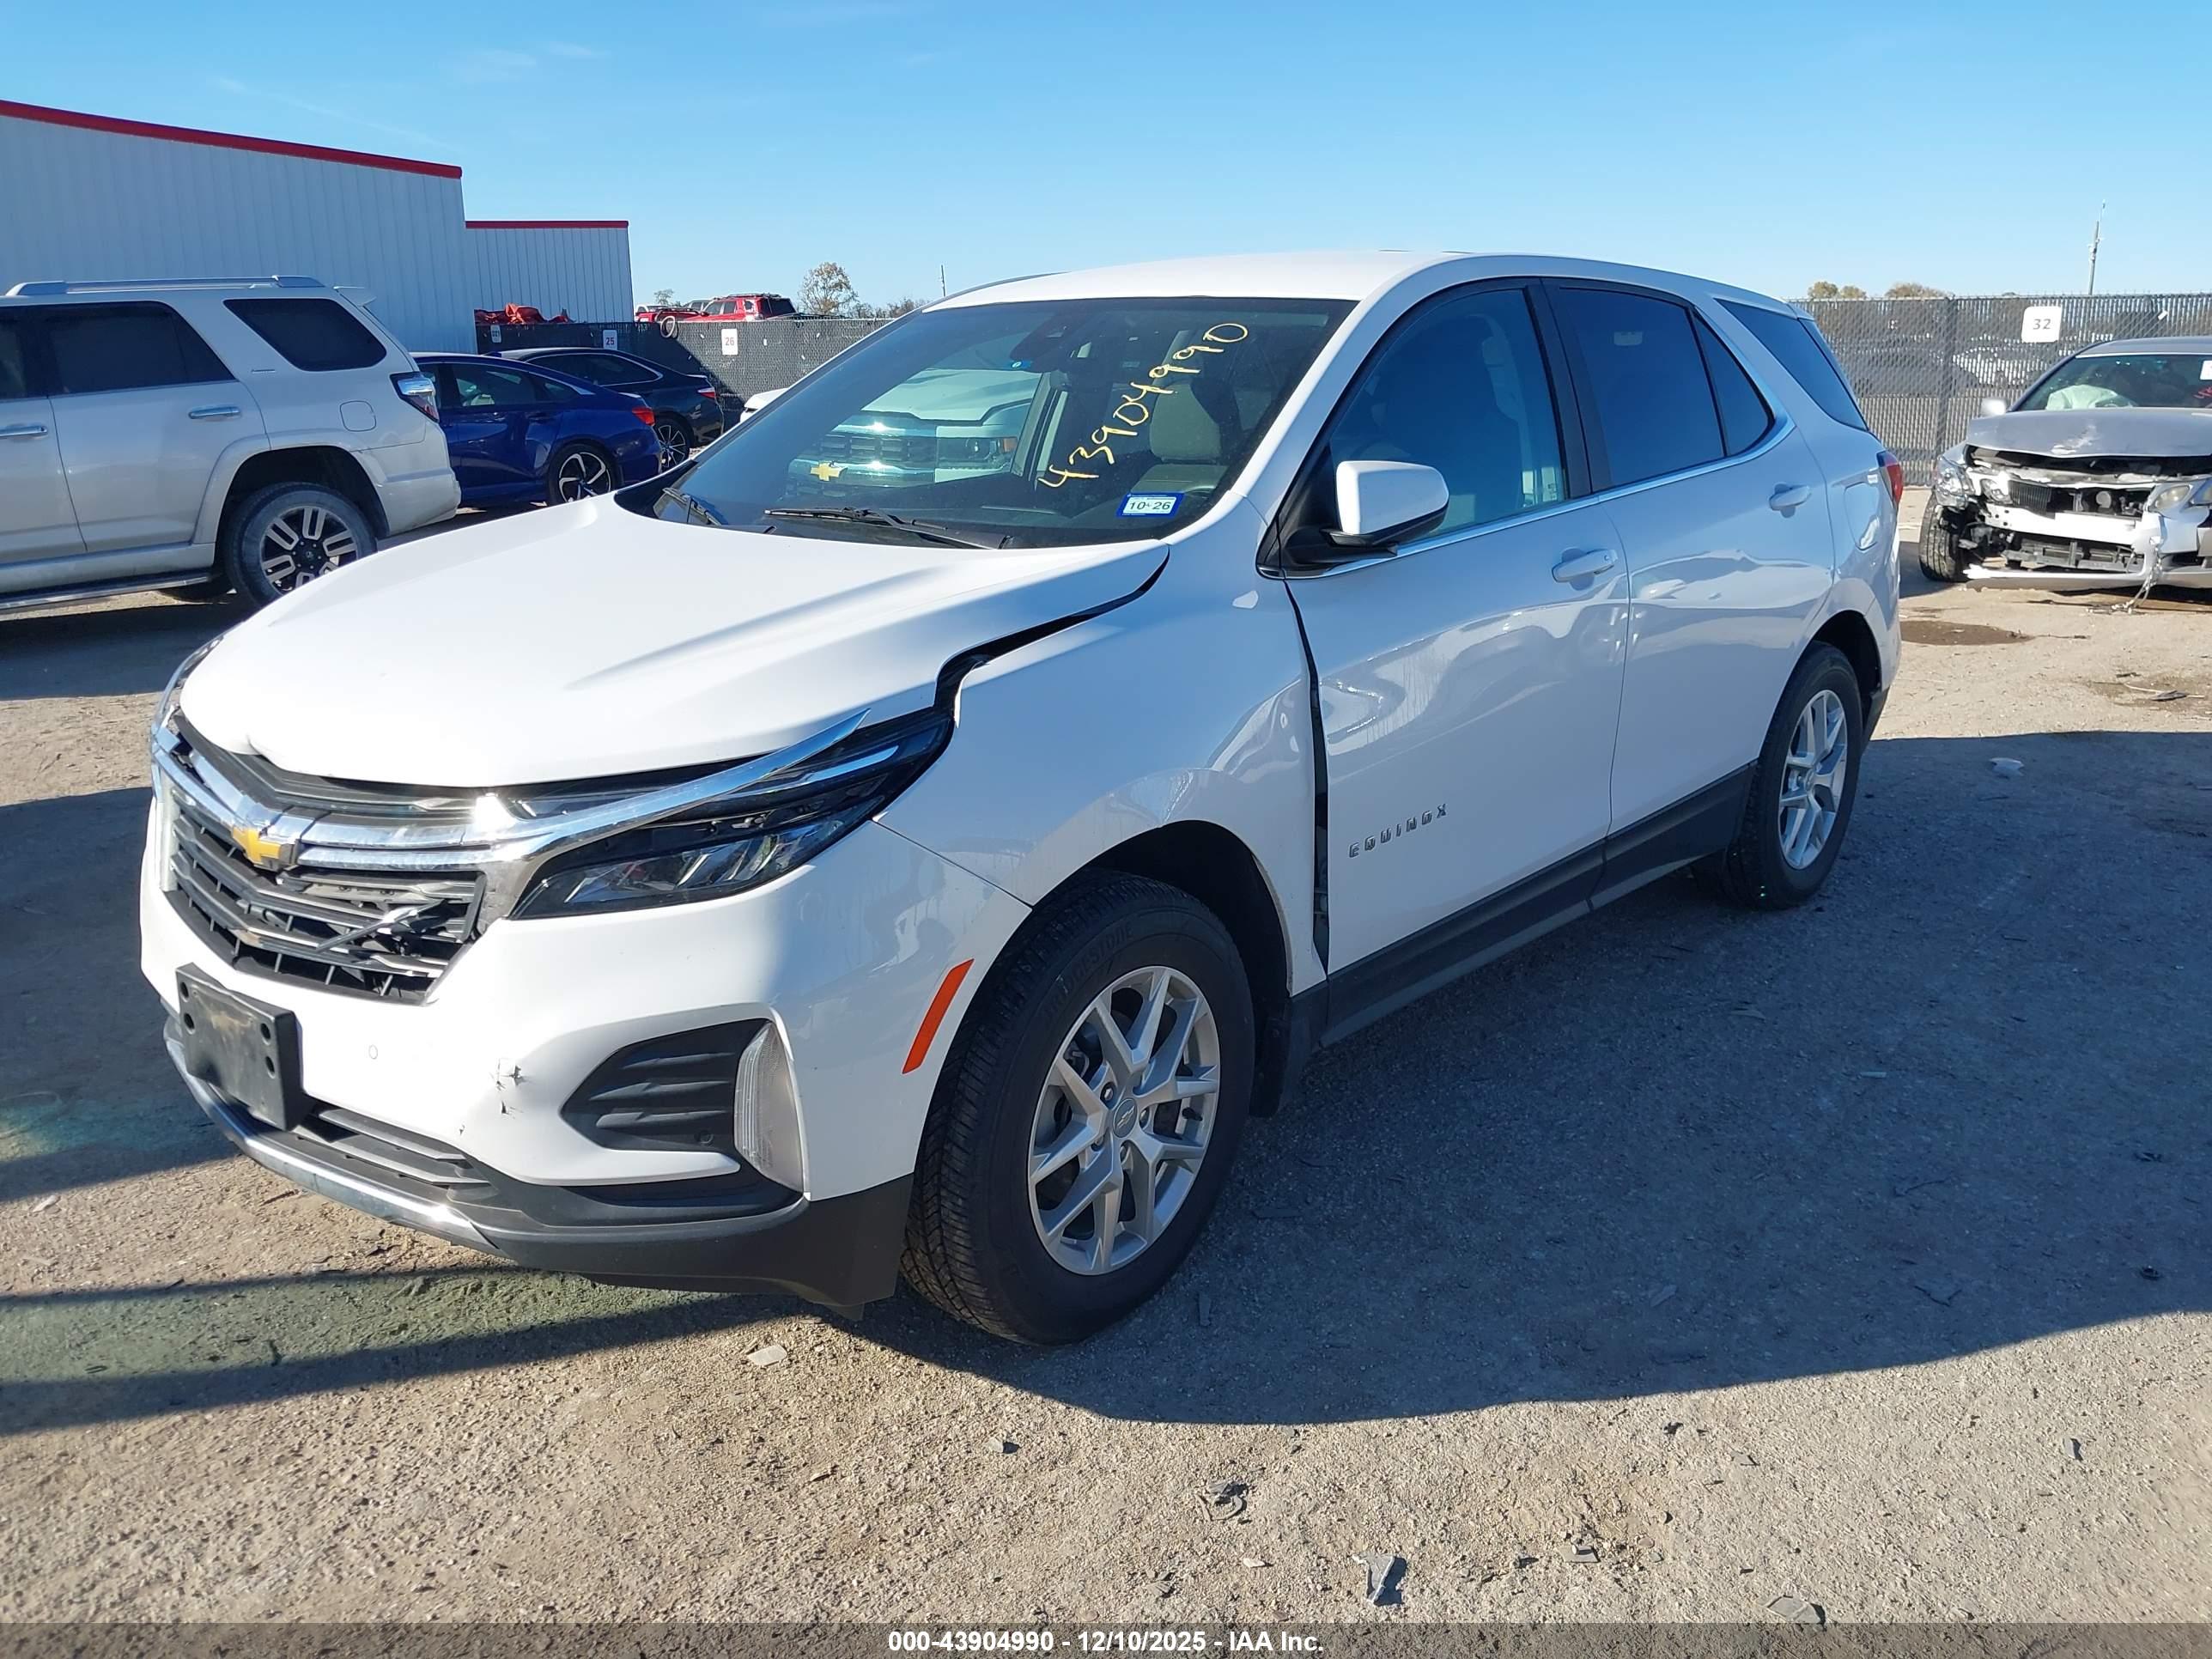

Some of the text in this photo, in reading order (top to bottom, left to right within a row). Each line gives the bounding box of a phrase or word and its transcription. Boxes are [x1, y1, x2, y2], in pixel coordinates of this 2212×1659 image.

[2033, 318, 2051, 330] 32
[605, 337, 615, 345] 25
[725, 337, 735, 346] 26
[1037, 323, 1248, 488] 43904990
[1348, 803, 1448, 858] EQUINOX
